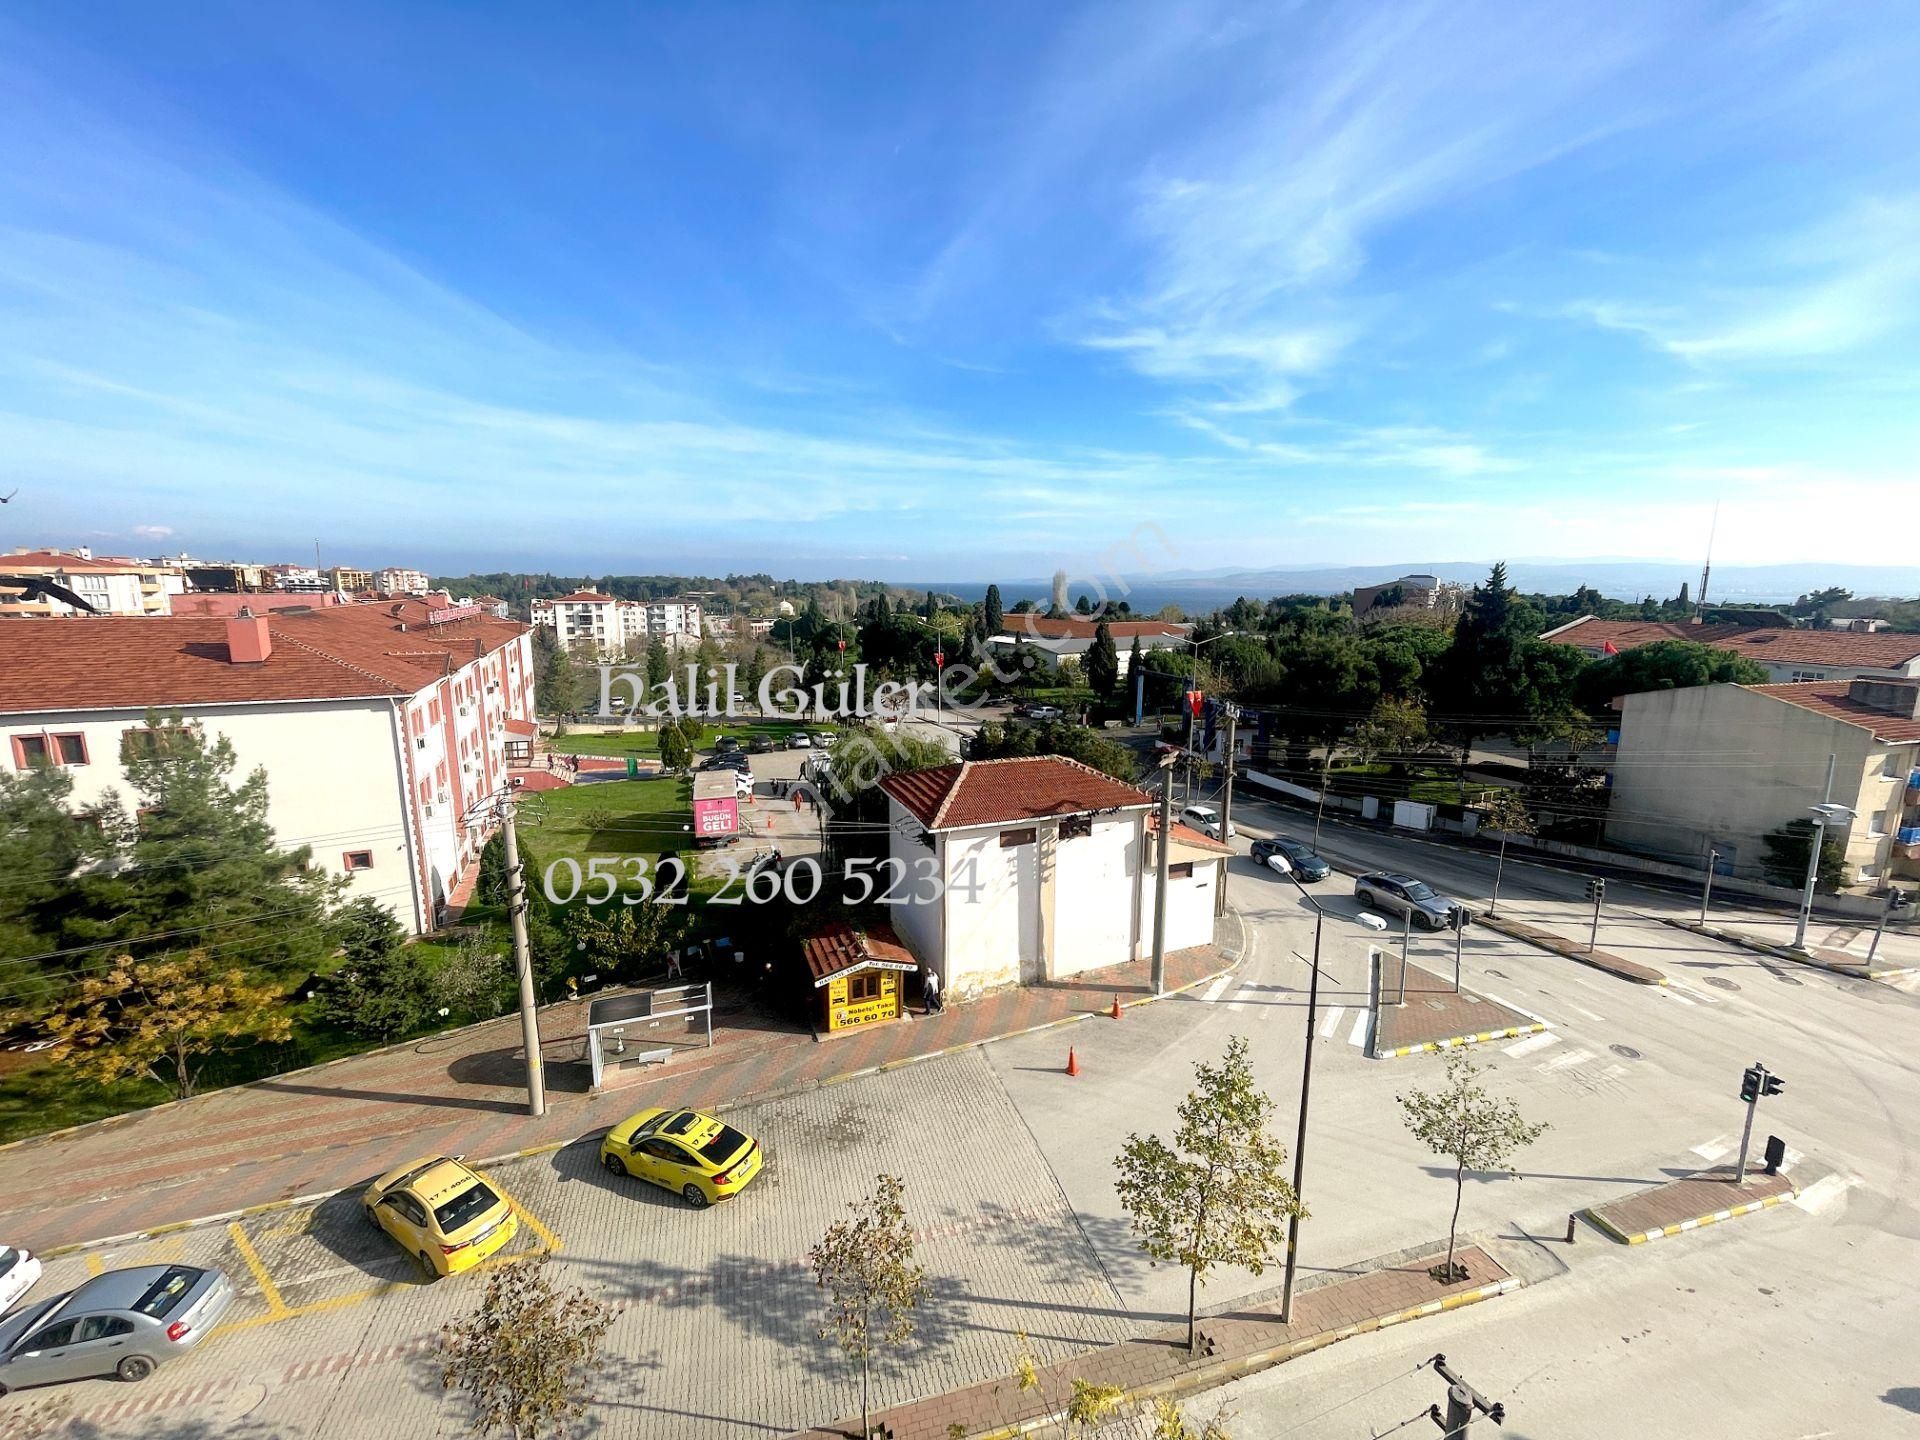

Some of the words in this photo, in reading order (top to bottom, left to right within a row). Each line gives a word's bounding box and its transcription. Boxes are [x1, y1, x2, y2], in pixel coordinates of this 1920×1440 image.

[703, 813, 731, 822] BUGÜN
[887, 971, 894, 980] 5
[840, 1017, 860, 1026] 566
[864, 1013, 878, 1021] 60
[881, 1010, 895, 1018] 70
